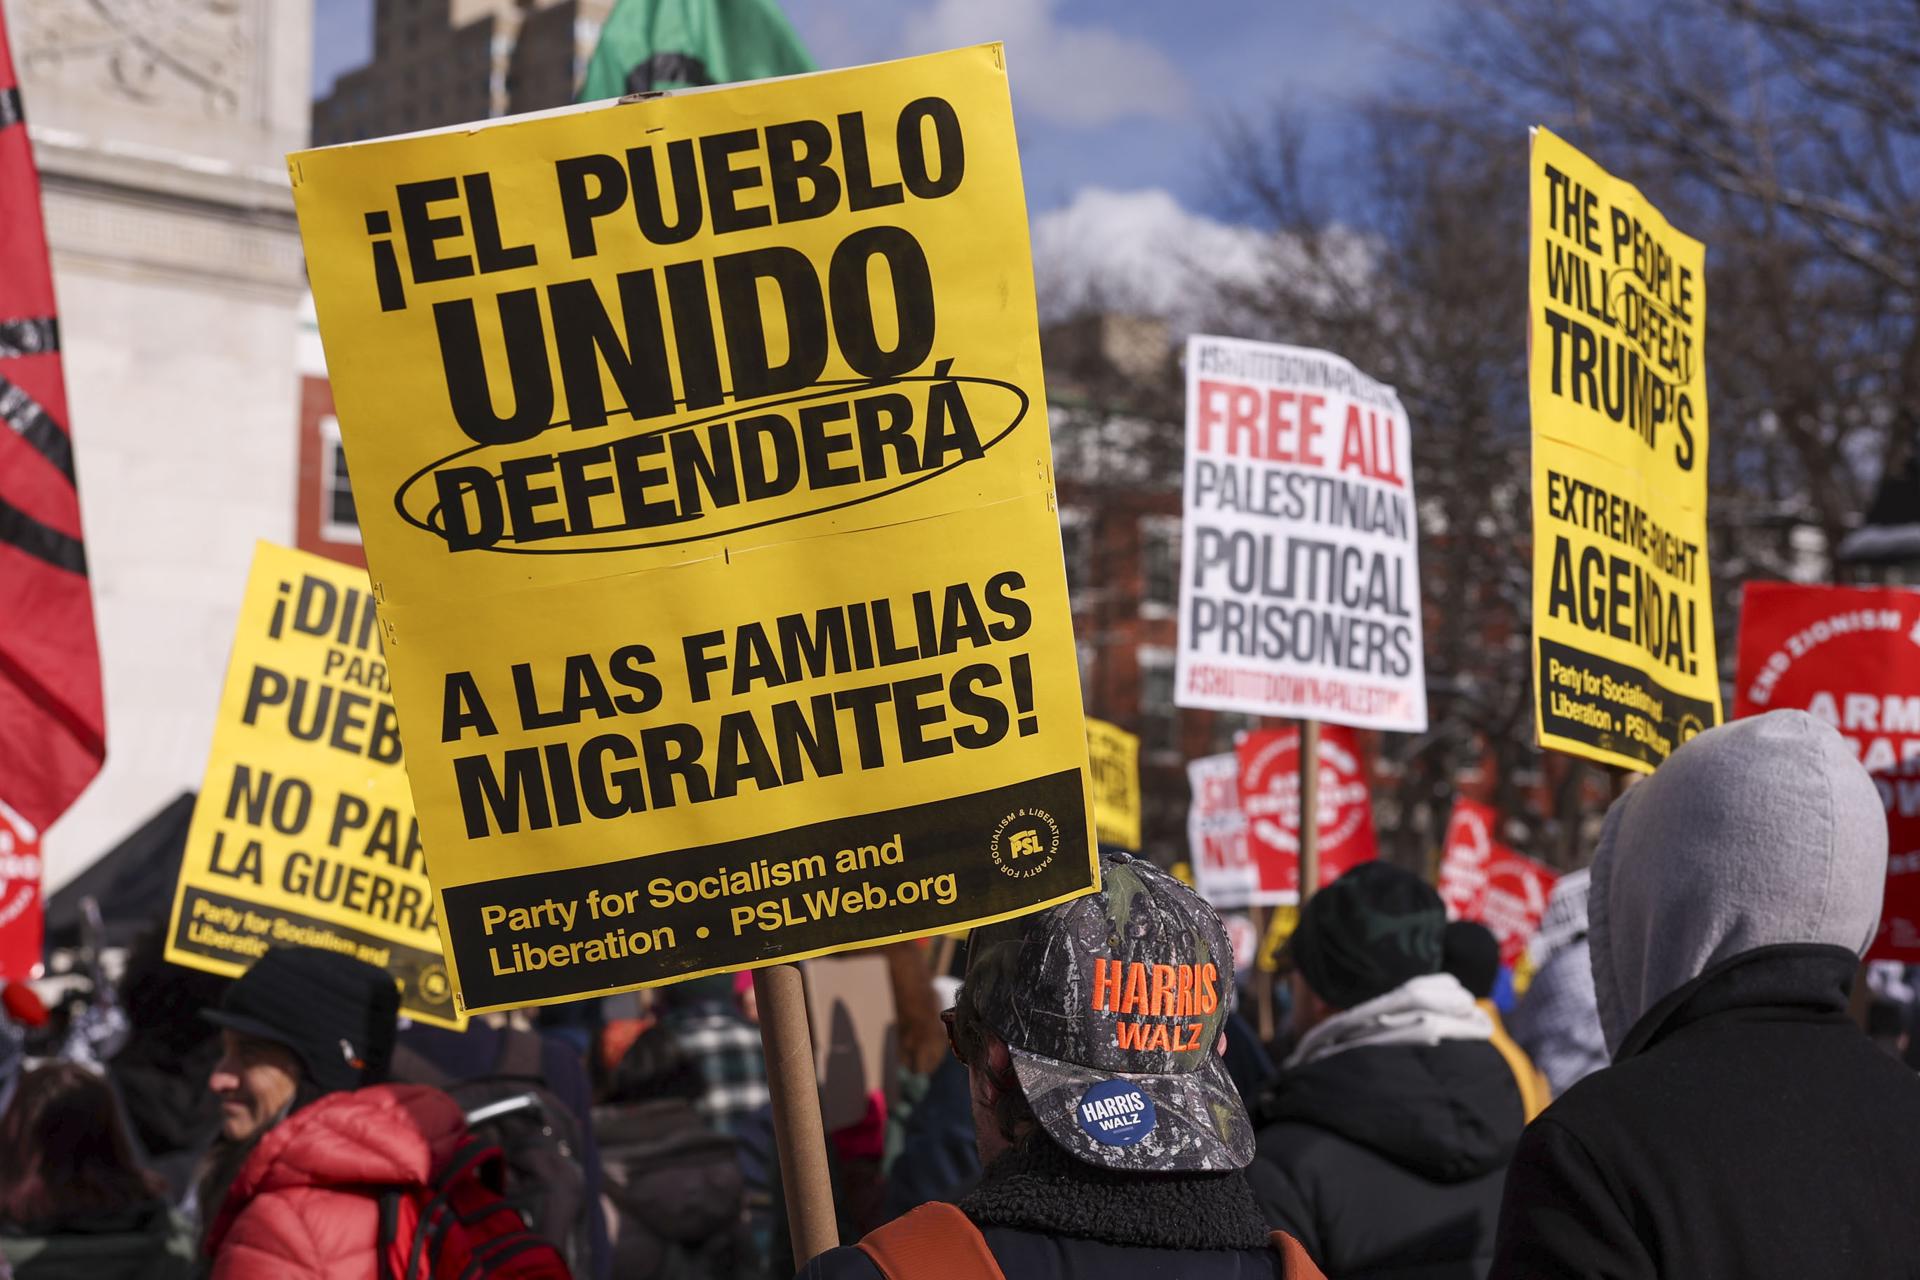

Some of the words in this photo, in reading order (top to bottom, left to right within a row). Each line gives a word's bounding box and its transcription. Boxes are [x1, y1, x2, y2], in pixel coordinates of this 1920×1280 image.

[364, 172, 538, 312] ¡EL
[555, 96, 966, 260] PUEBLO
[1545, 163, 1602, 256] THE
[1610, 204, 1692, 325] PEOPLE
[432, 225, 936, 444] UNIDO
[1546, 238, 1616, 328] WILL
[1625, 281, 1692, 385] DEFEAT
[1545, 307, 1694, 472] TRUMP'S
[434, 358, 985, 553] DEFENDERÁ
[1197, 379, 1325, 467] FREE
[1338, 403, 1404, 488] ALL
[1193, 460, 1408, 540] PALESTINIAN
[1193, 526, 1411, 618] POLITICAL
[1548, 534, 1698, 677] AGENDA!
[441, 671, 499, 743] A
[511, 644, 663, 731] LAS
[682, 570, 1033, 704] FAMILIAS
[1190, 596, 1412, 678] PRISONERS
[1549, 657, 1582, 696] Party
[1582, 668, 1601, 696] for
[453, 652, 1039, 840] MIGRANTES!
[1551, 690, 1613, 732] Liberation
[224, 763, 313, 836] NO
[990, 812, 1017, 865] SOCIALISM
[1028, 807, 1060, 854] LIBERATION
[208, 831, 263, 886] LA
[480, 898, 577, 935] Party
[587, 889, 639, 919] for
[648, 853, 826, 909] Socialism
[836, 833, 904, 875] and
[1000, 864, 1020, 878] FOR
[1010, 835, 1044, 859] PSL
[1023, 856, 1053, 878] PARTY
[488, 921, 676, 976] Liberation
[730, 871, 958, 937] PSLWeb.org
[1091, 958, 1218, 1017] HARRIS
[1116, 1021, 1204, 1052] WALZ
[1082, 1092, 1145, 1123] HARRIS
[1098, 1113, 1141, 1131] WALZ
